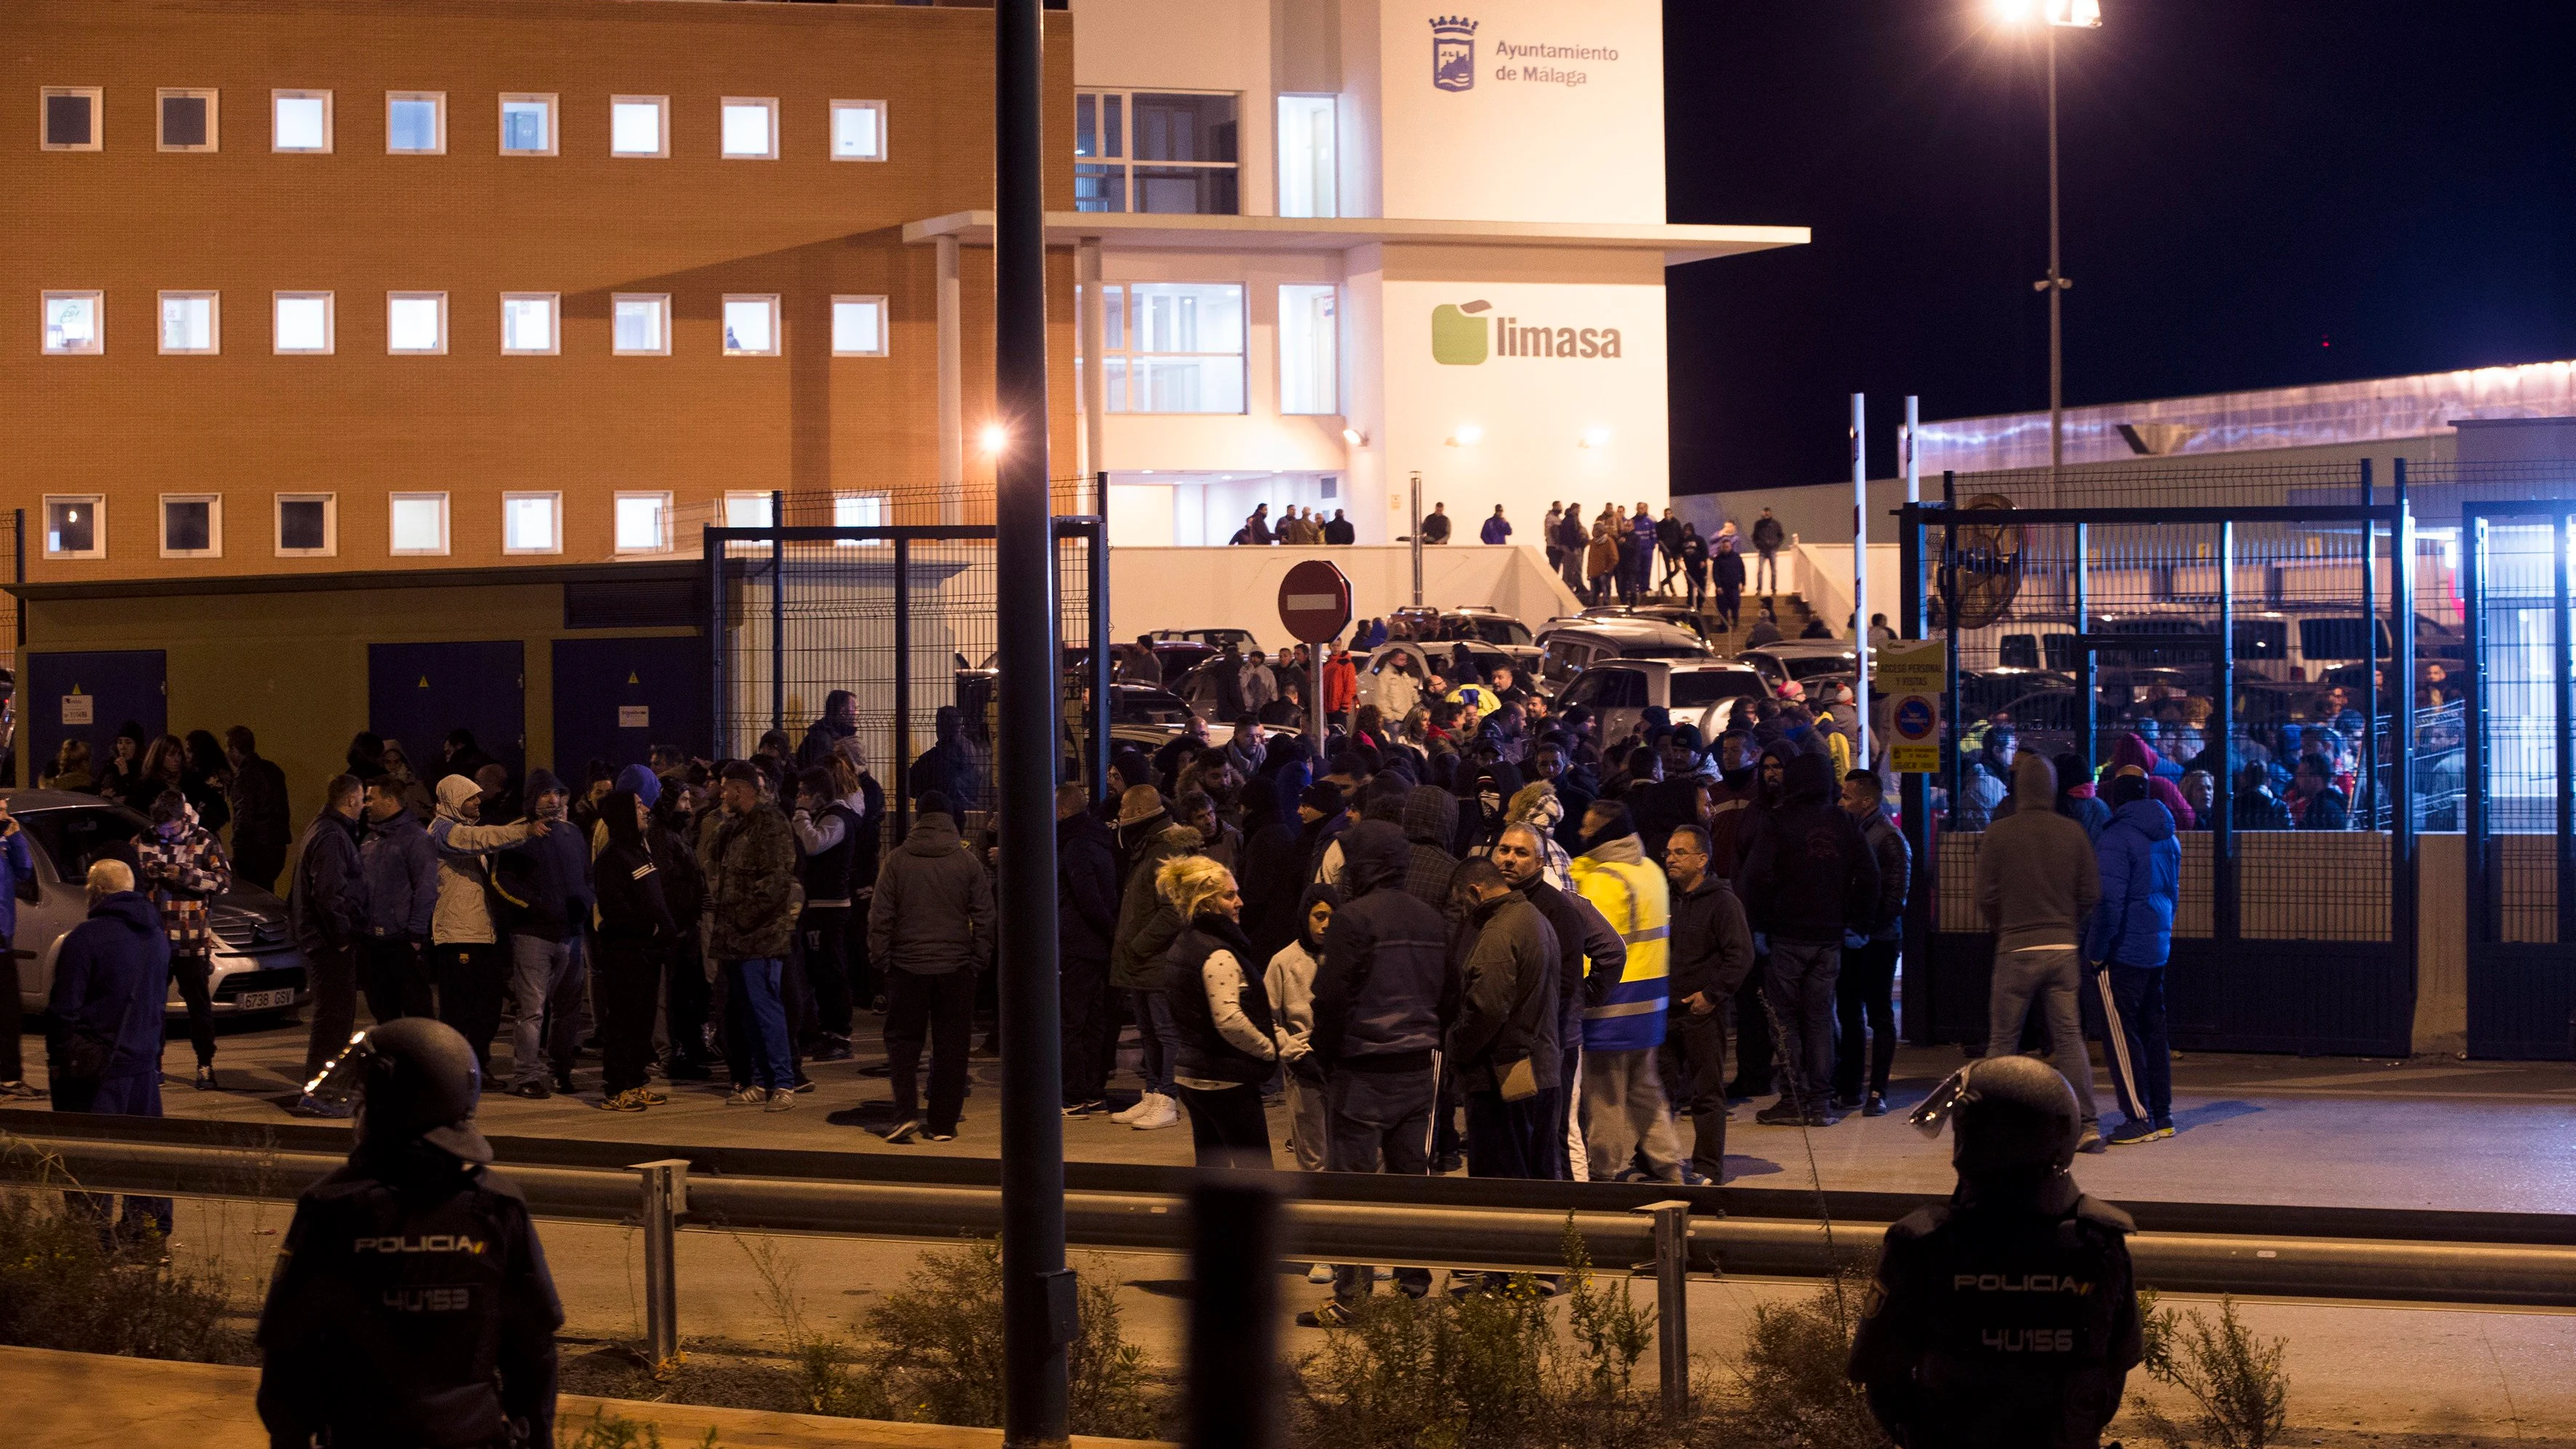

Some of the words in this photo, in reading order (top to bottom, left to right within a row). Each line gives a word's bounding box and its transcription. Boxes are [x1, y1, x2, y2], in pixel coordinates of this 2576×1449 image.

[1496, 40, 1619, 61] Ayuntamiento
[1496, 66, 1517, 81] de
[1523, 65, 1587, 87] Málaga
[1496, 317, 1622, 359] limasa
[1880, 664, 1906, 673] ACCESO
[1909, 664, 1942, 673] PERSONAL
[1902, 677, 1927, 686] VISITAS
[246, 993, 269, 1008] 6738
[353, 1235, 473, 1253] POLICIA
[1954, 1274, 2079, 1296] POLICIA
[1981, 1328, 2074, 1352] 4U156
